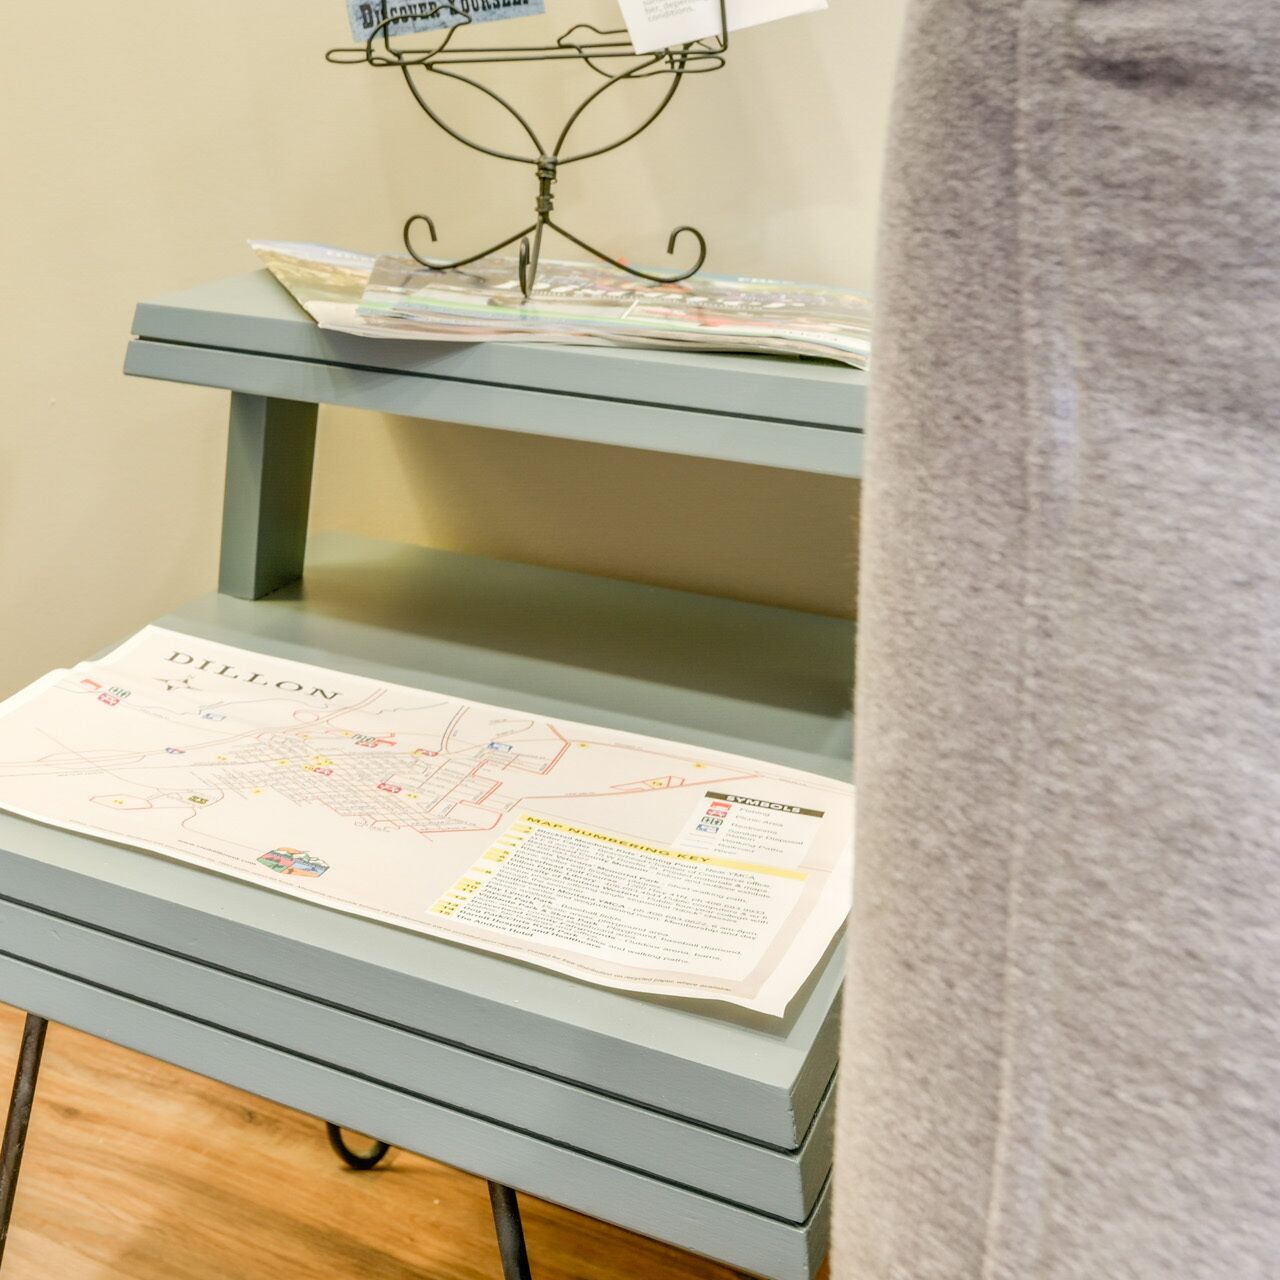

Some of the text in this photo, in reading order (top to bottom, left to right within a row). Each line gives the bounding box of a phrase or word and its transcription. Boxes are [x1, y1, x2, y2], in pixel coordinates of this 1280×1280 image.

[164, 650, 343, 701] DILLON
[726, 794, 801, 813] SYMBOLS
[527, 816, 711, 862] MAP NUMBERING KEY
